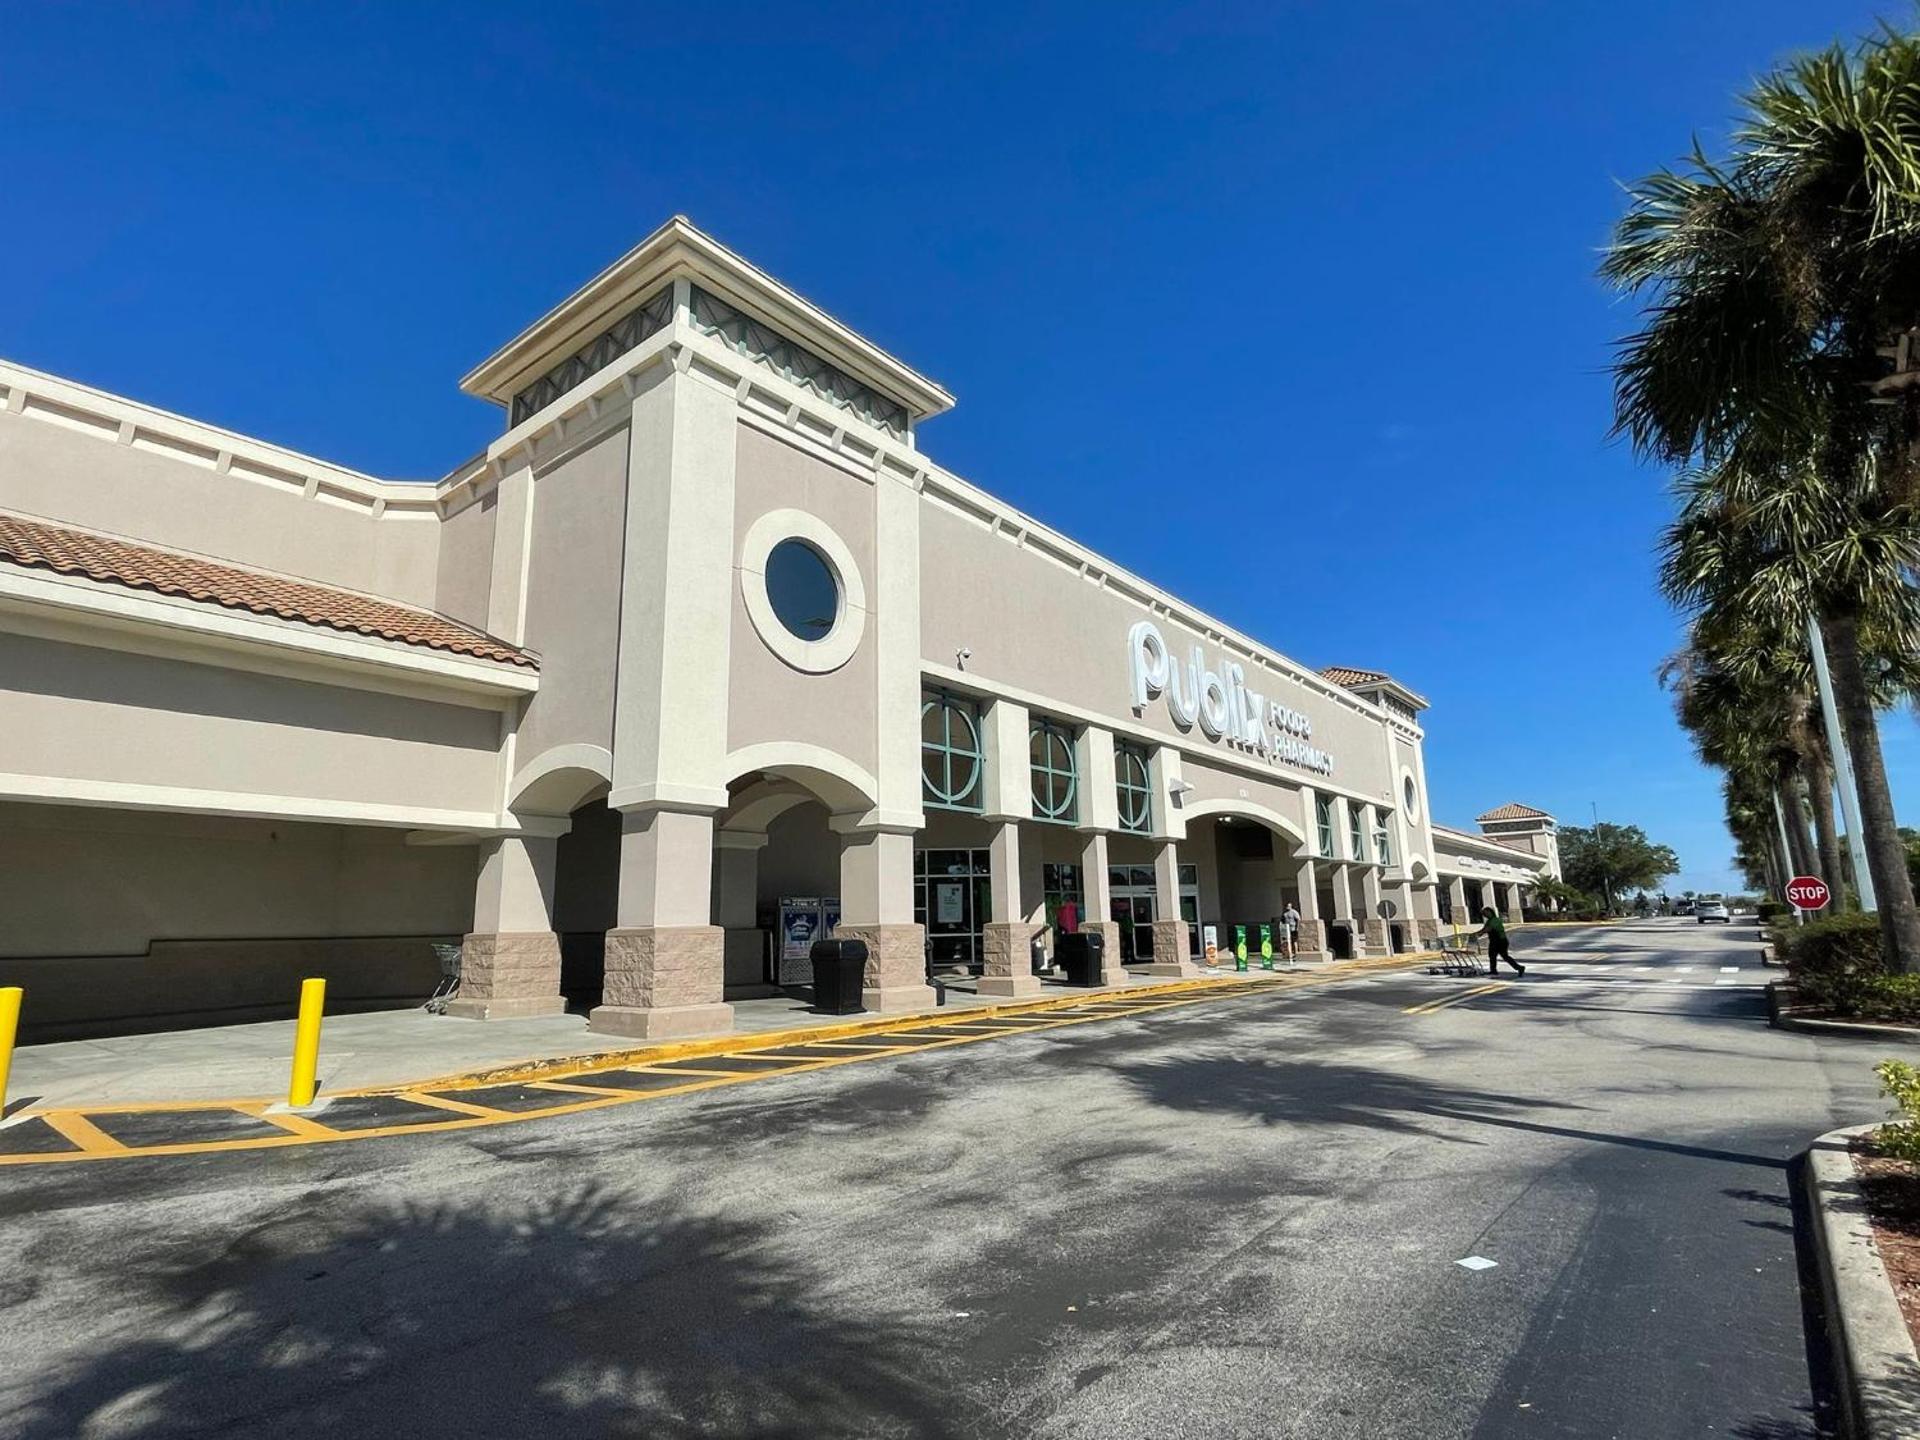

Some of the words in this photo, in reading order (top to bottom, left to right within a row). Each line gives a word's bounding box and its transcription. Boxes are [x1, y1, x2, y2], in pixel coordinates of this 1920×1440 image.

[1128, 620, 1269, 748] Publix
[1274, 734, 1334, 772] PHARMACY
[1789, 886, 1825, 900] STOP
